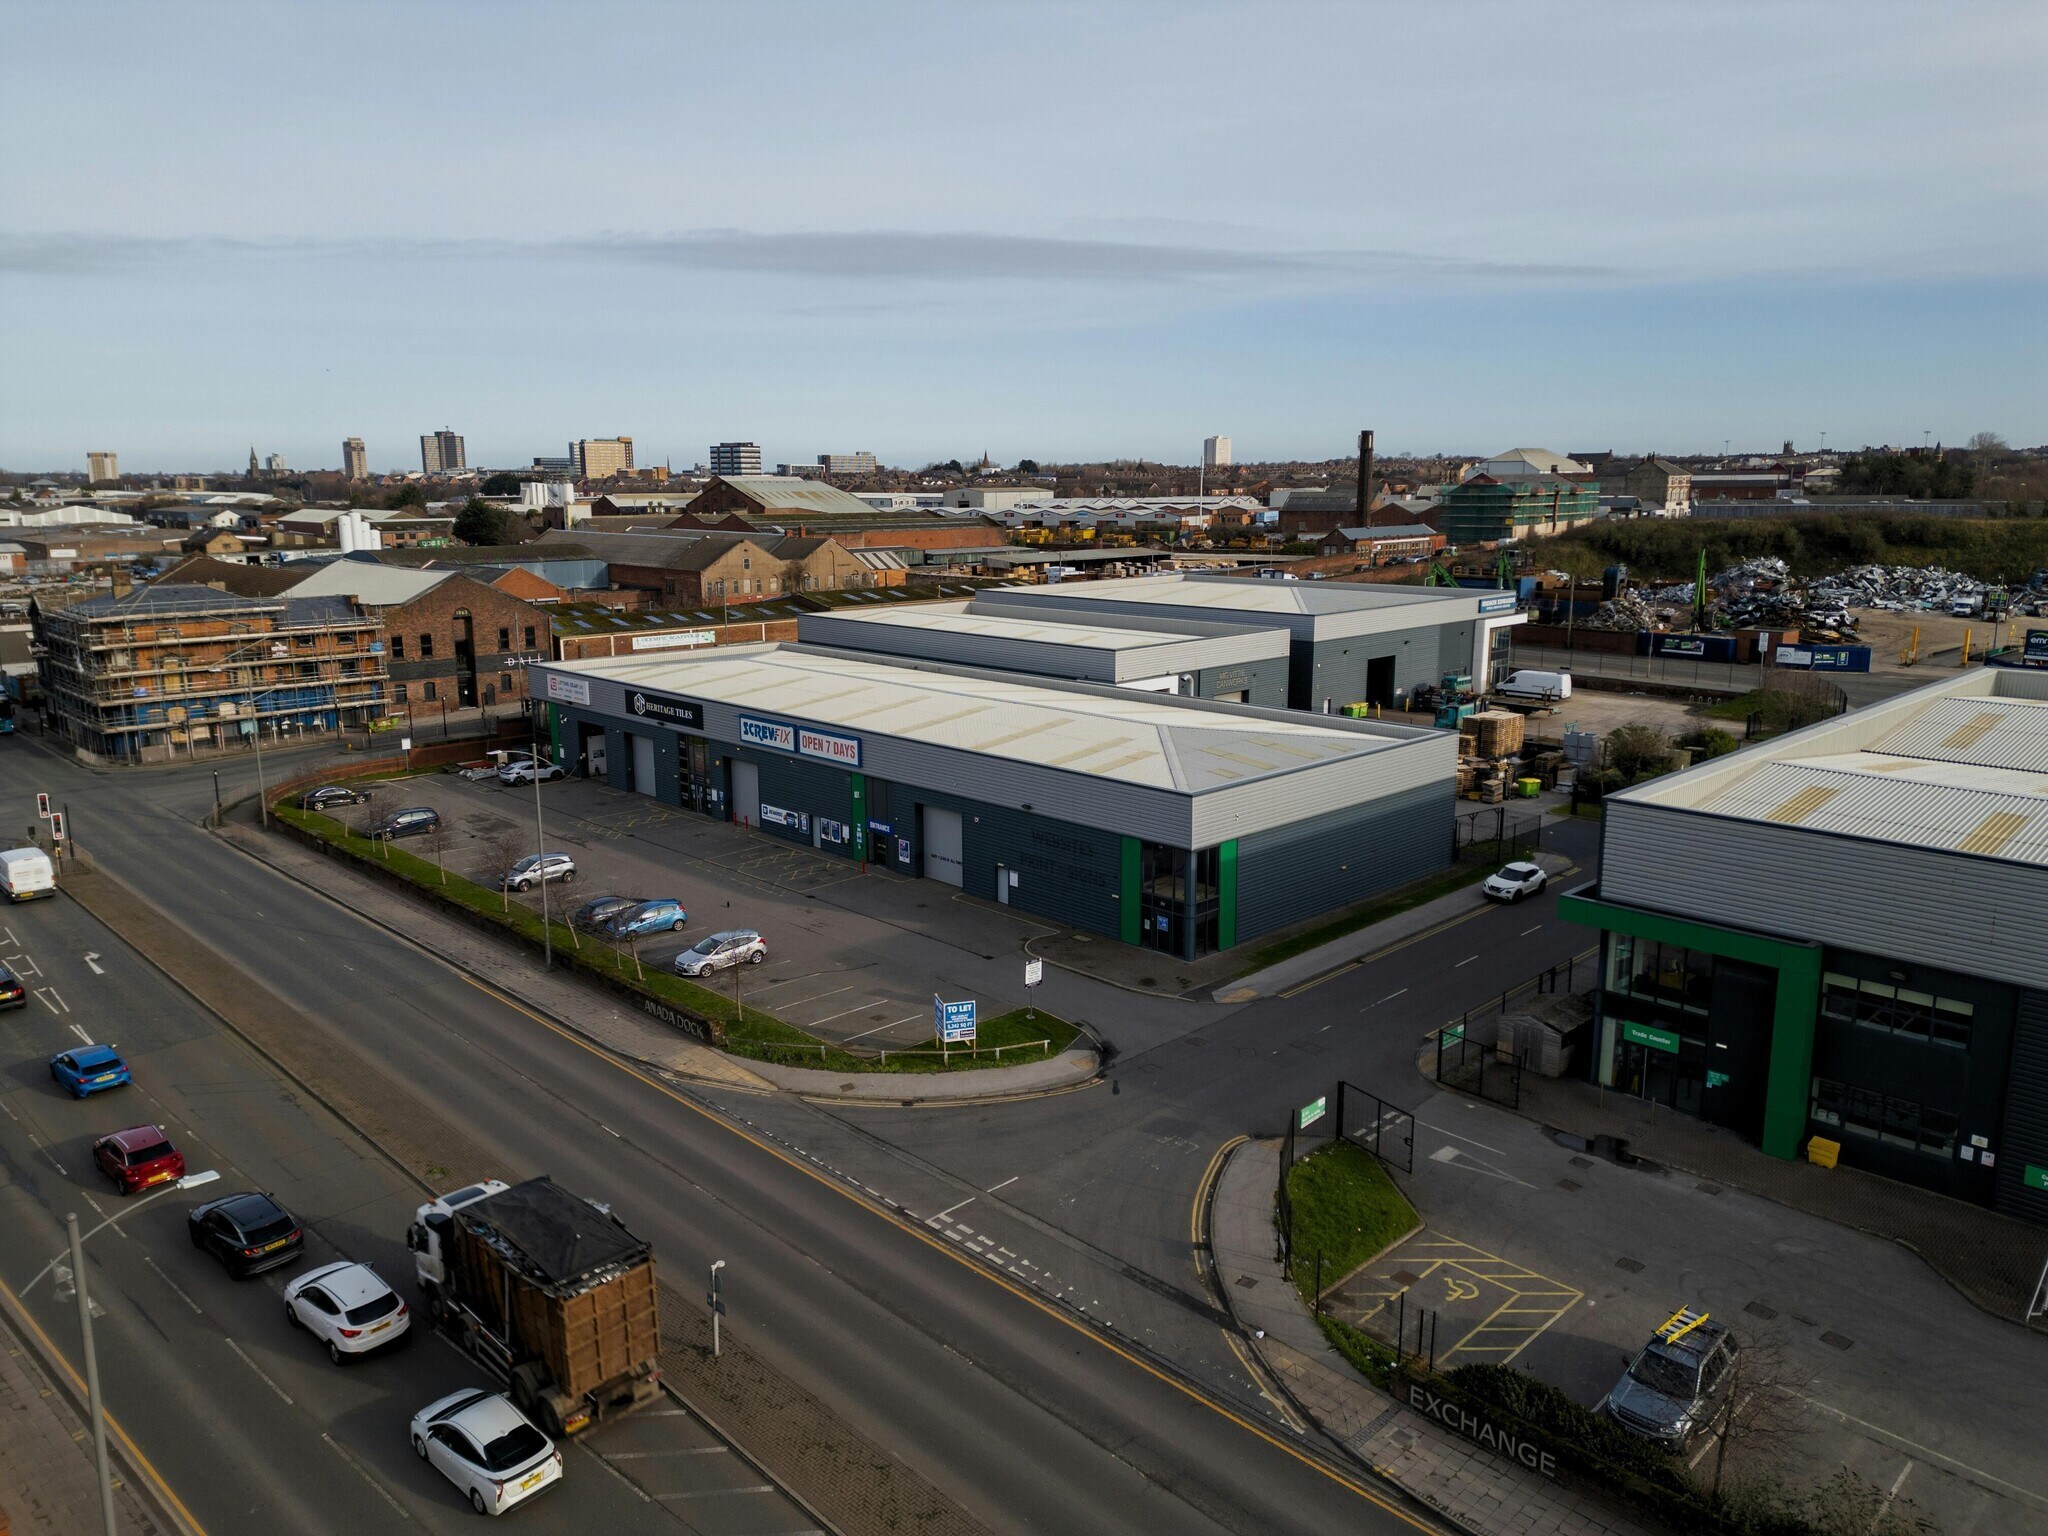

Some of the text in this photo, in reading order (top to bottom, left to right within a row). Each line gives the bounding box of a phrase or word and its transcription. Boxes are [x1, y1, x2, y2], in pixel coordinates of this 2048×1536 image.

[645, 701, 693, 719] HERITAGE TILES
[742, 721, 791, 745] SCREWFIX
[802, 735, 856, 759] OPEN 7 DAYS
[869, 821, 890, 833] ENTRANCE
[947, 1004, 973, 1014] TO LET
[644, 1000, 704, 1040] ANADA DOCK
[1631, 1029, 1671, 1045] Trade Counter
[1410, 1384, 1556, 1478] EXCHANGE
